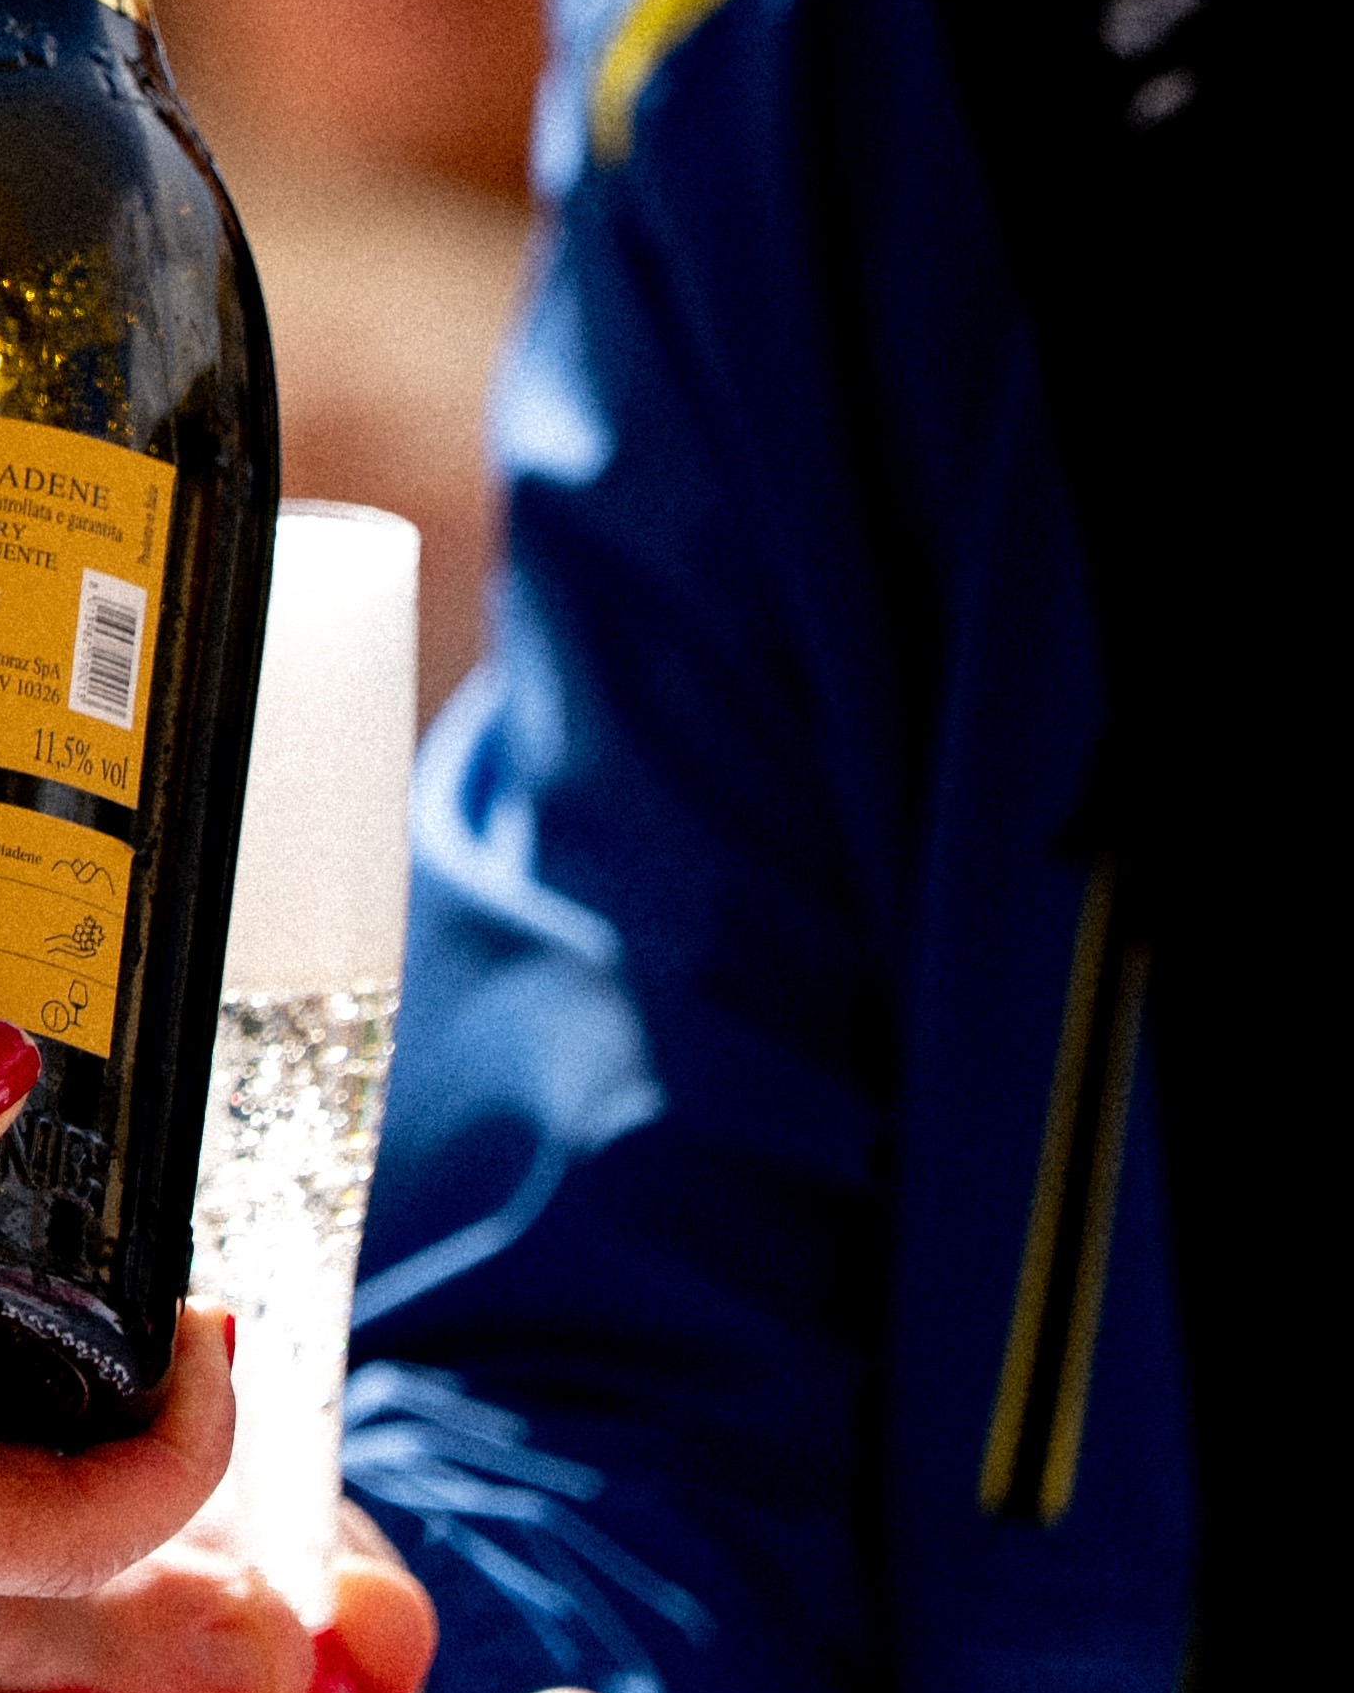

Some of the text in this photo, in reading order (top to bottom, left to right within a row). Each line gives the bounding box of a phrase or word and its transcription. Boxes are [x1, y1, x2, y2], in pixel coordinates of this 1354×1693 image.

[56, 511, 65, 525] e
[68, 513, 124, 544] garantita
[33, 657, 61, 682] SpA
[17, 678, 61, 706] 10326
[34, 727, 129, 790] 11,5% vol
